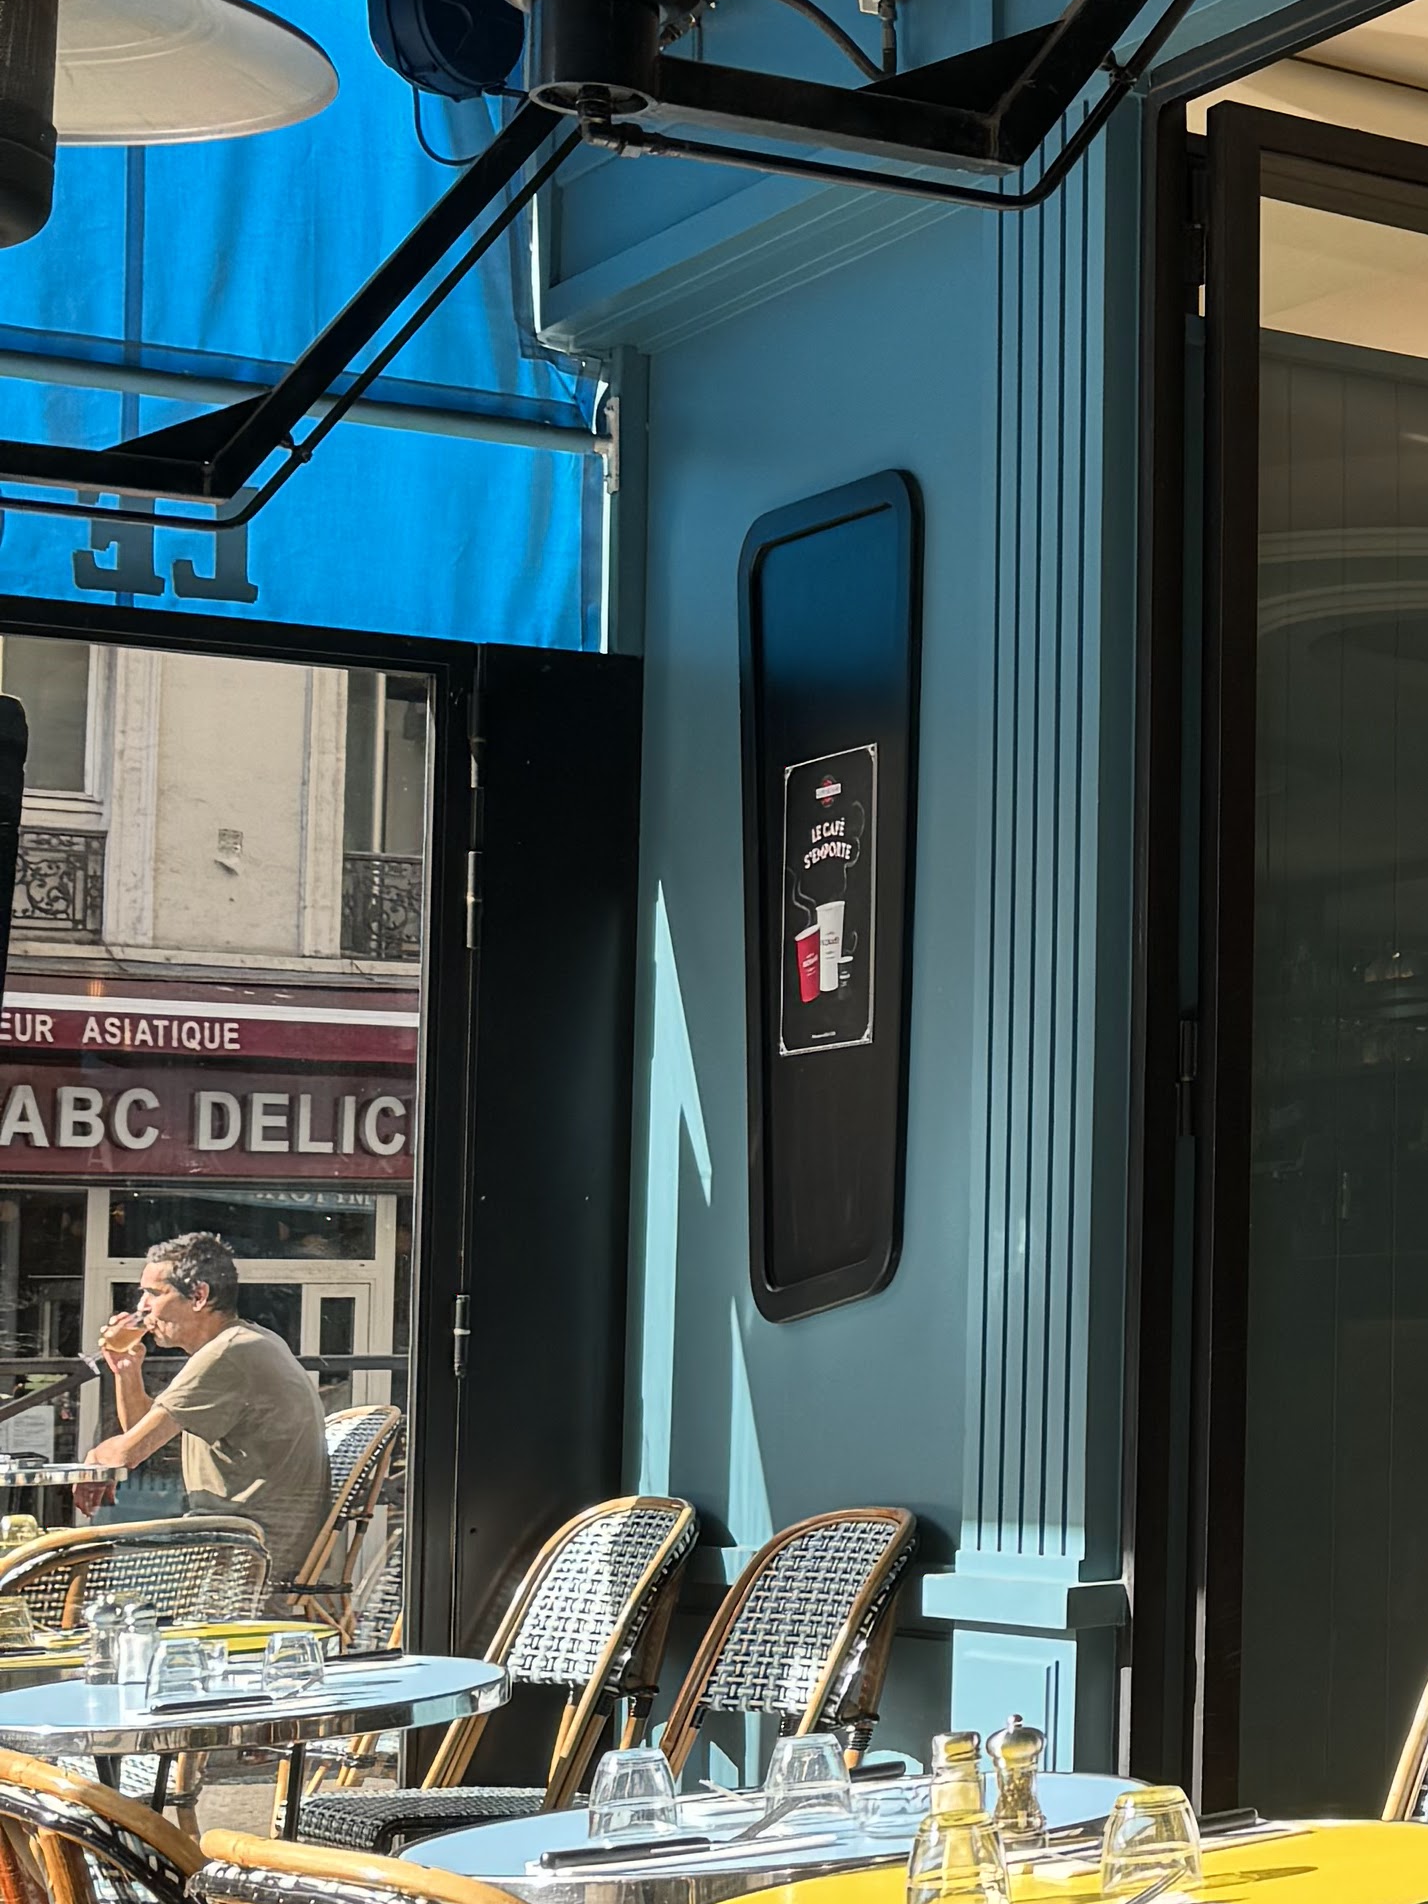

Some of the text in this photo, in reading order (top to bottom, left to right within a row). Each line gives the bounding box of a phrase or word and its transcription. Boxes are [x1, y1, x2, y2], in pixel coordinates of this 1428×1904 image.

[82, 1015, 241, 1050] ASIATIQUE
[0, 1084, 414, 1156] ABC DELIC
